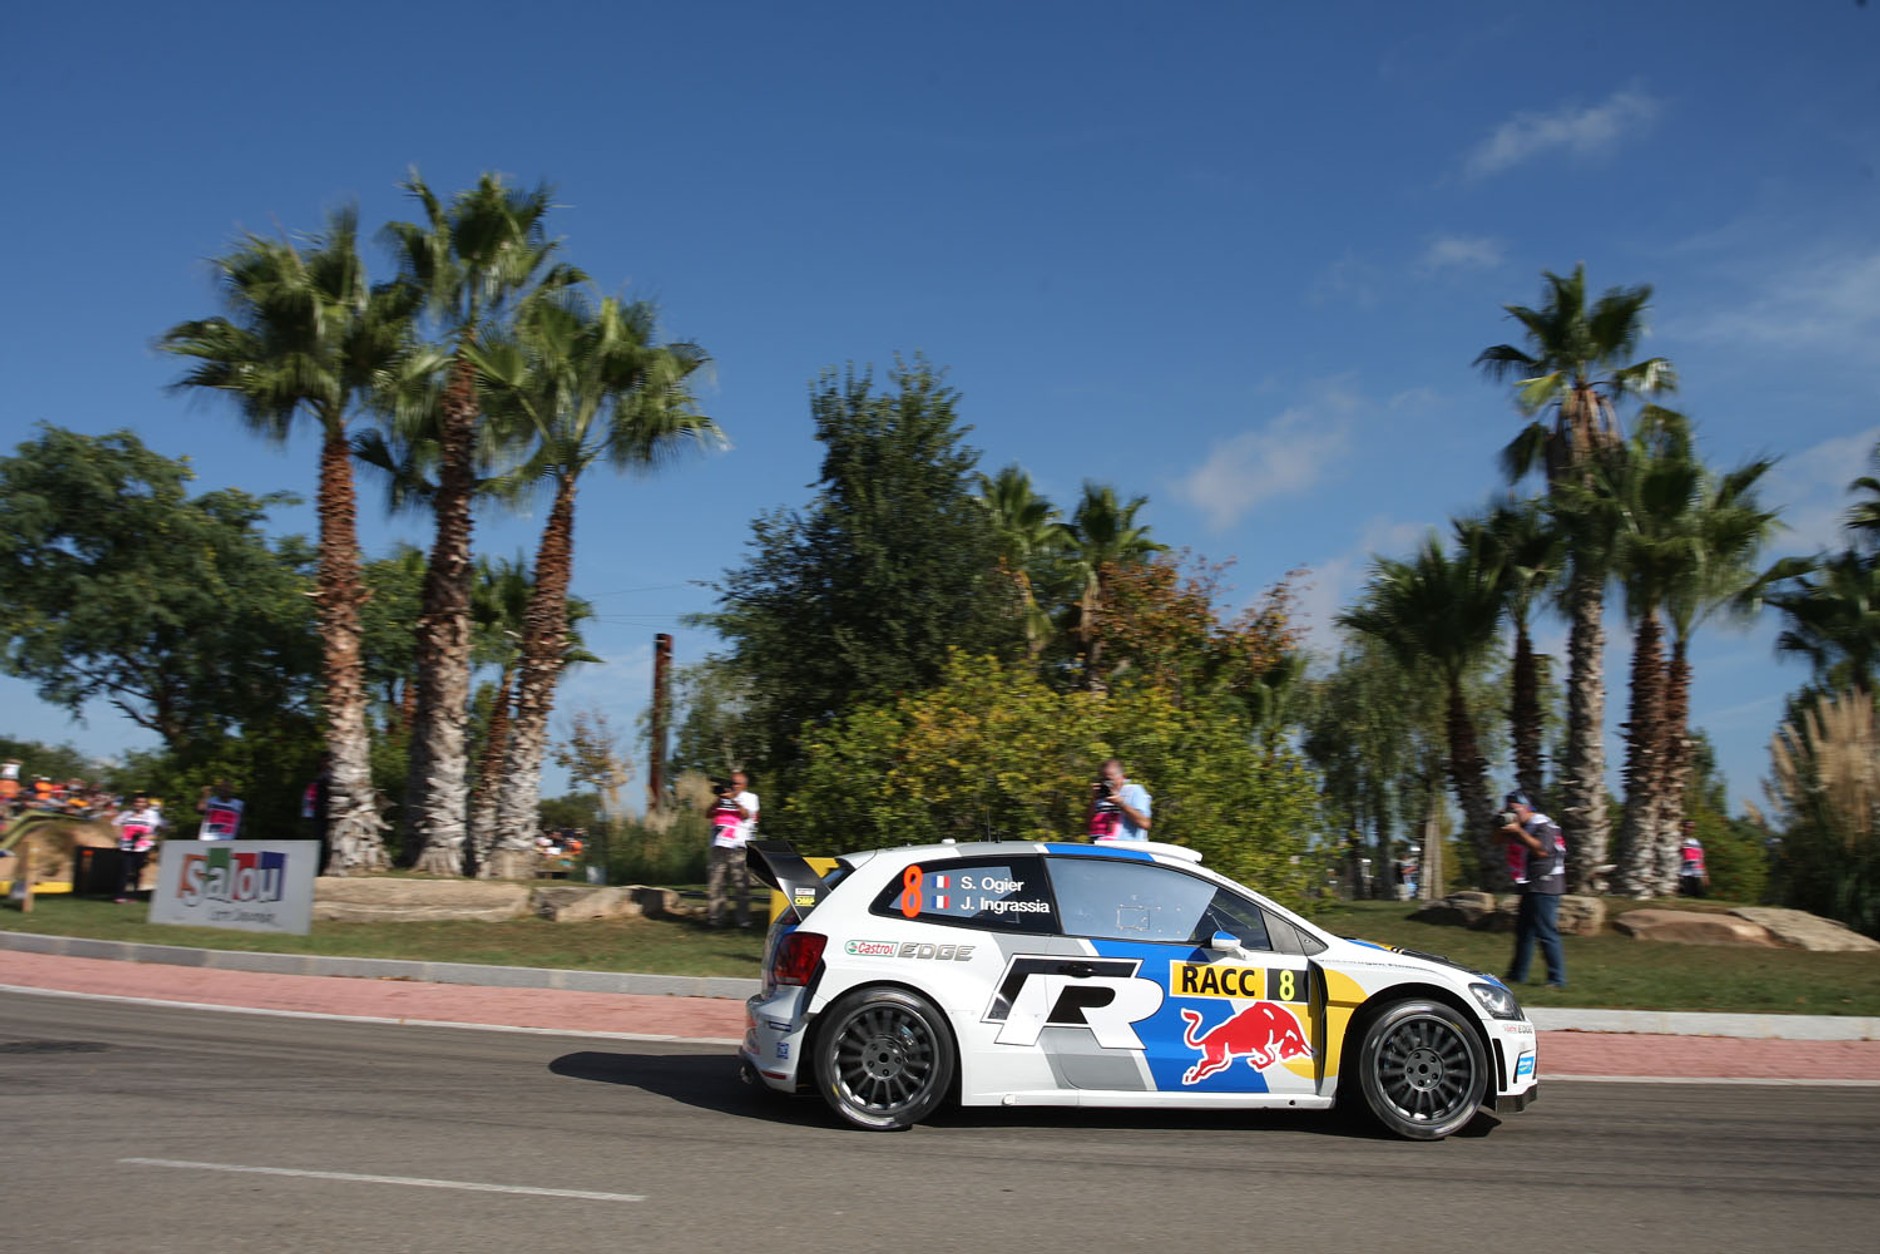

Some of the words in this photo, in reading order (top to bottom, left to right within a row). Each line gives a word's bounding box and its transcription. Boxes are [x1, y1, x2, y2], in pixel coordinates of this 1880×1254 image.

[901, 865, 923, 918] 8
[960, 876, 977, 890] S.
[981, 876, 1025, 893] Ogier
[960, 896, 975, 911] J.
[980, 897, 1050, 914] Ingrassia
[858, 942, 895, 955] Castrol
[897, 942, 977, 961] EDGE
[1182, 965, 1255, 997] RACC
[1279, 969, 1295, 1001] 8
